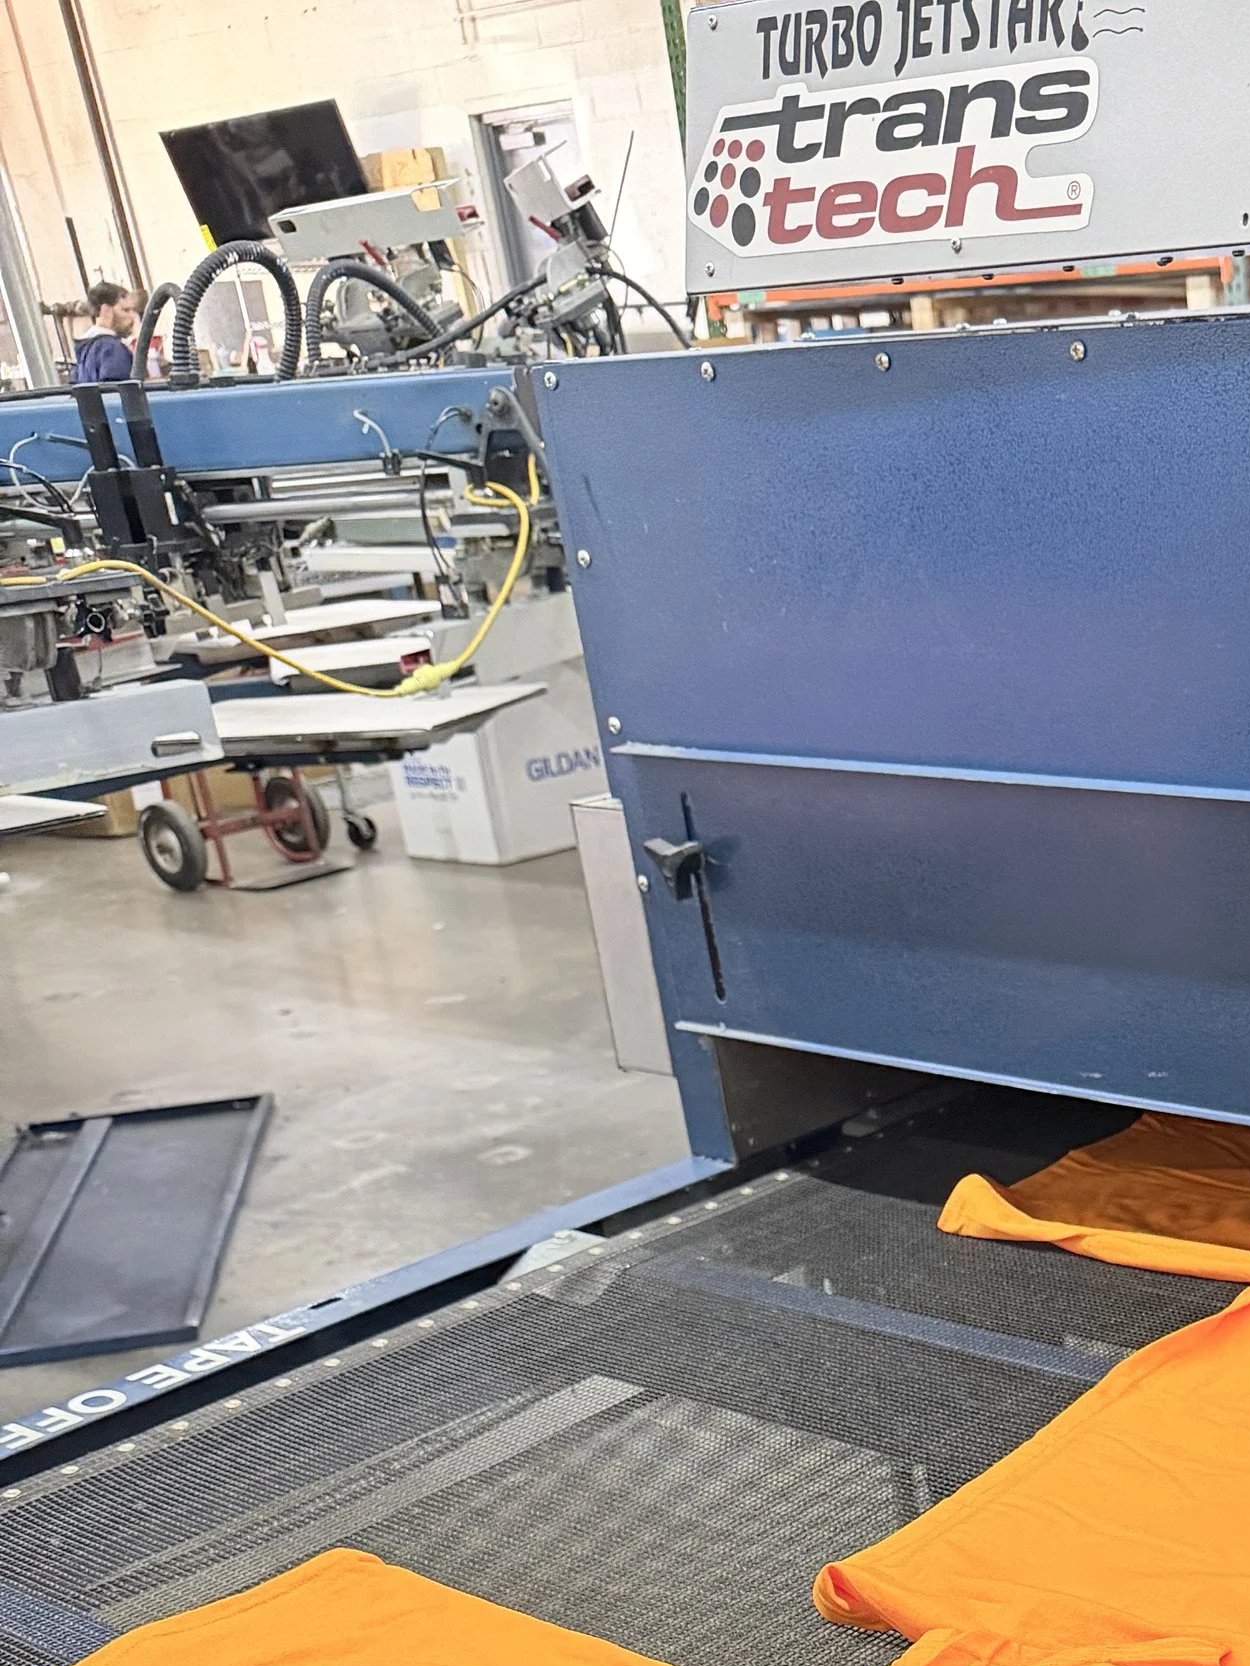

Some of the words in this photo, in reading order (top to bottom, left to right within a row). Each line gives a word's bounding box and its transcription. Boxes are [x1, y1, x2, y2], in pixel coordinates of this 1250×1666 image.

[756, 0, 884, 80] TURBO
[720, 68, 1091, 164] trans
[762, 144, 1083, 246] tech
[525, 745, 601, 782] GILDAN
[125, 1323, 308, 1390] TAPE
[0, 1388, 128, 1451] OFF
